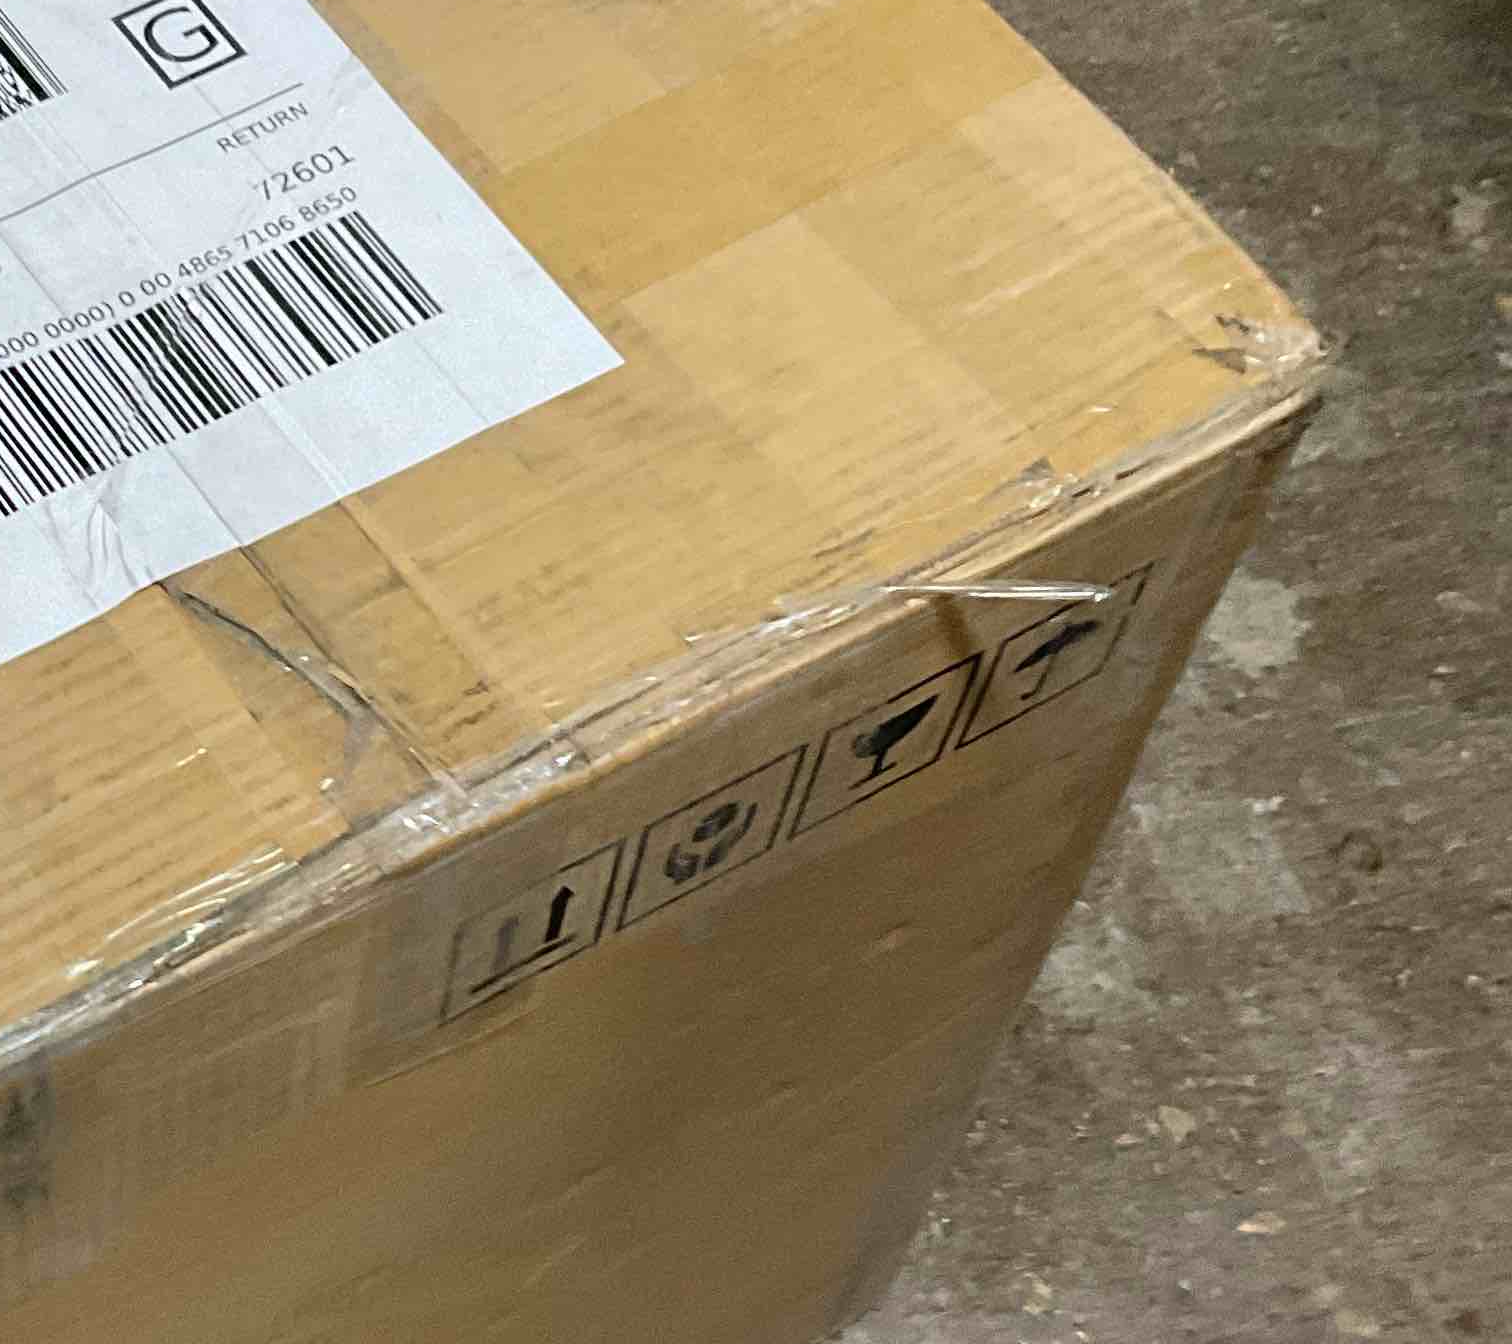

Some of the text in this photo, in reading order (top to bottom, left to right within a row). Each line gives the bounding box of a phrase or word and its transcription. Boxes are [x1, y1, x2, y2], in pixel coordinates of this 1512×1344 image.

[143, 5, 219, 63] G
[215, 101, 309, 153] RETURN
[252, 145, 356, 201] 72601
[43, 300, 116, 339] 0000)
[117, 290, 136, 308] 0
[139, 272, 172, 297] 00
[178, 245, 233, 278] 4865
[233, 214, 296, 251] 7106
[297, 183, 358, 223] 8650
